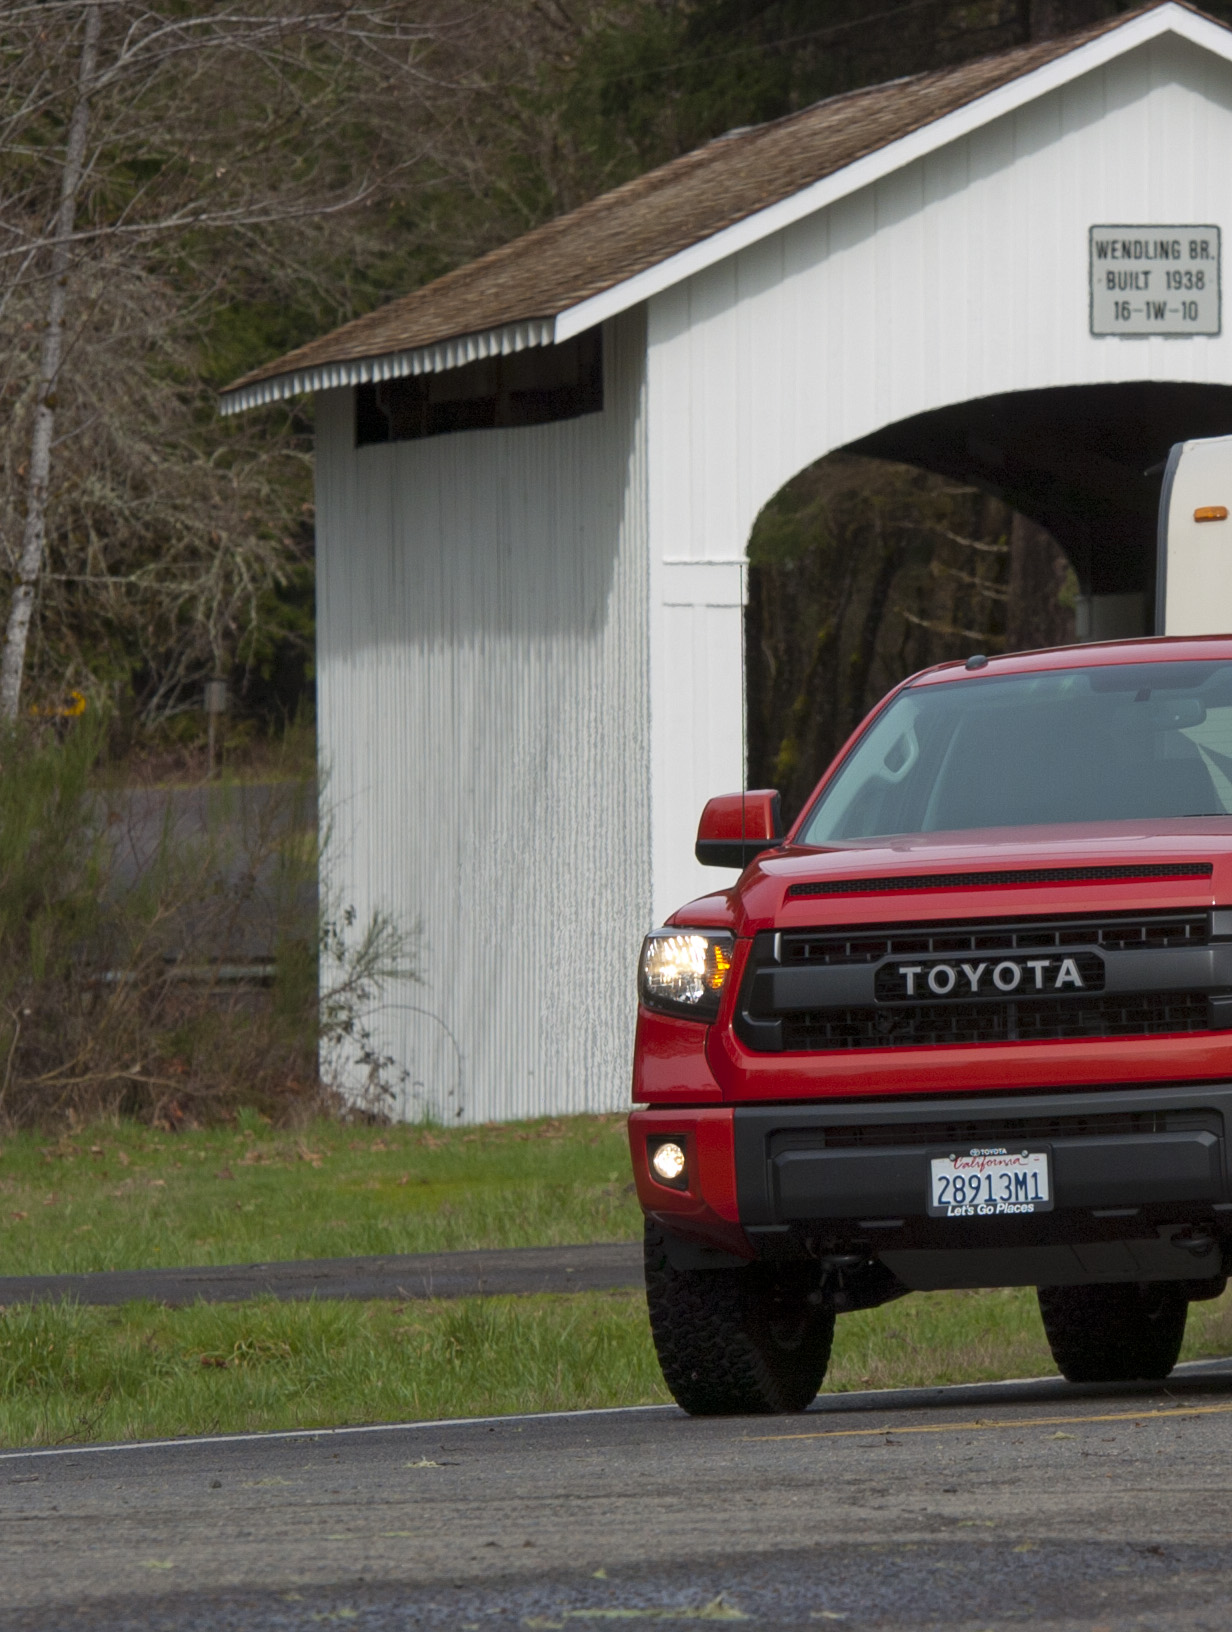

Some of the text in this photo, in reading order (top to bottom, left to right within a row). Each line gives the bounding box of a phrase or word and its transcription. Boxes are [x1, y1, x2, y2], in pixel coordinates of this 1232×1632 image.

[1095, 240, 1215, 260] WENDLING BR.
[1106, 270, 1206, 291] BUILT 1938
[1114, 301, 1199, 321] 16-1W-10
[899, 958, 1085, 996] TOYOTA
[953, 1156, 1029, 1173] California
[937, 1171, 1044, 1205] 28913M1
[947, 1203, 1035, 1217] Let's Go Places
